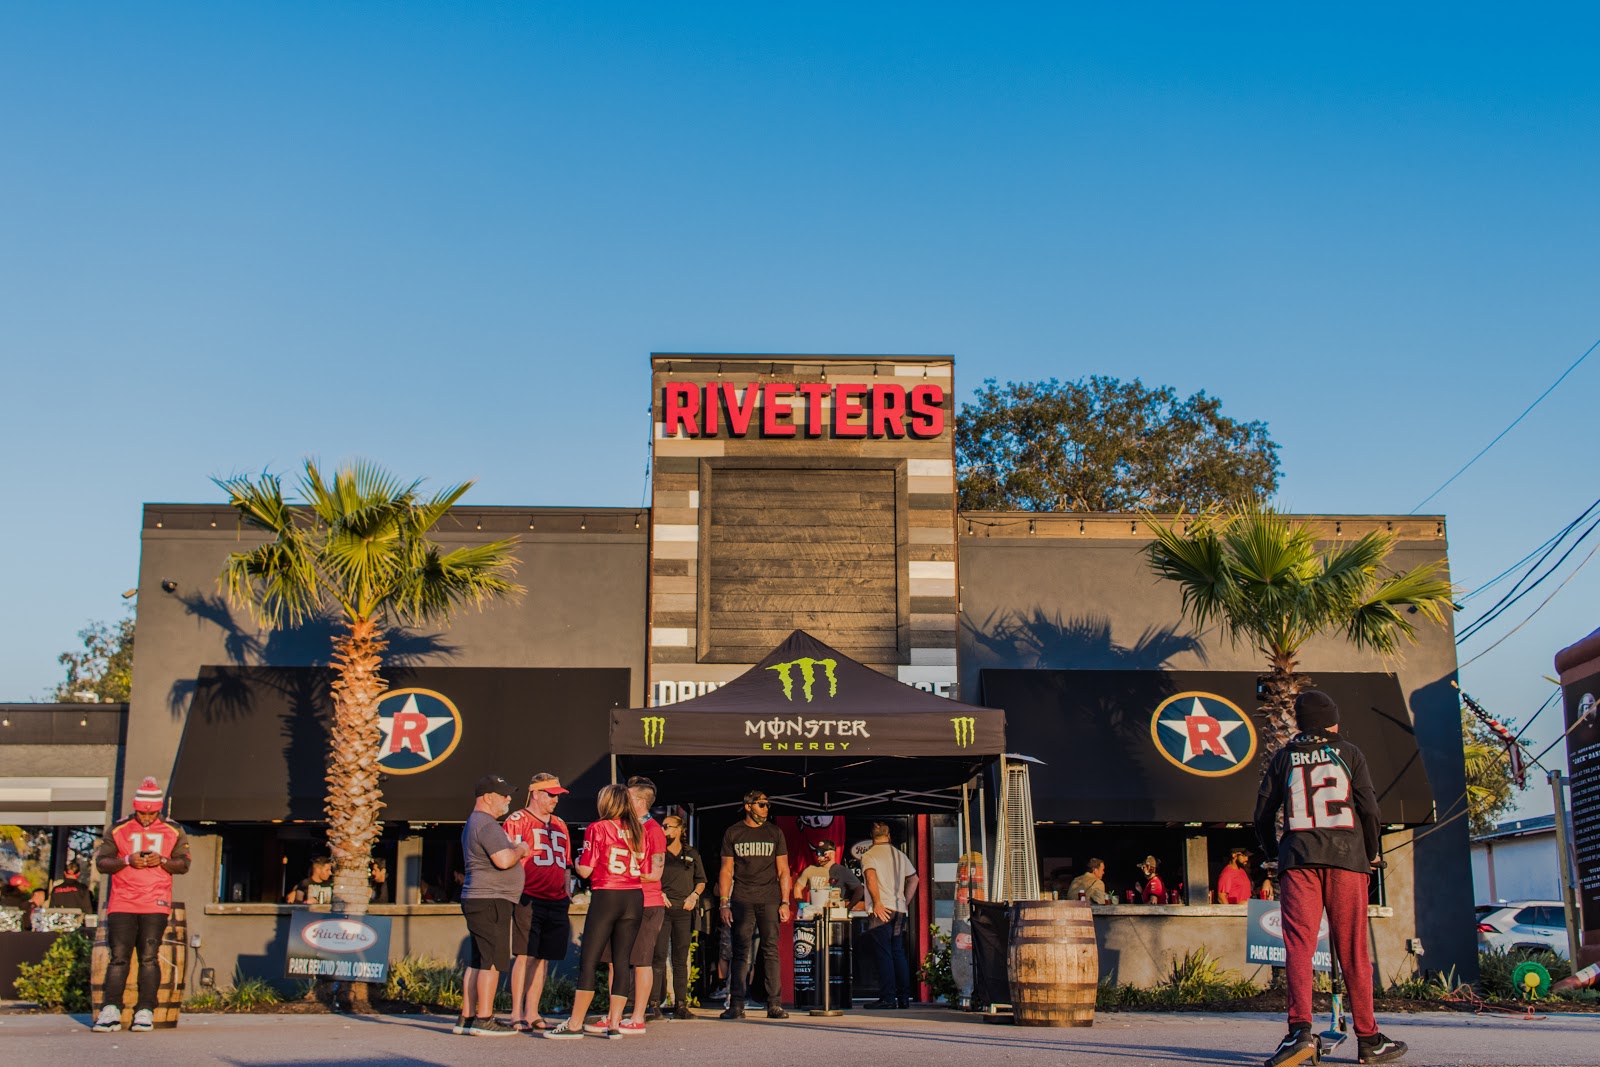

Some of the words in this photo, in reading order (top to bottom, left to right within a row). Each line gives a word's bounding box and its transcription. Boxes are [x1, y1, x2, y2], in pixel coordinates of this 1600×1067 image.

[665, 381, 944, 437] RIVETERS
[389, 711, 429, 753] R
[744, 716, 871, 740] MONSTER
[1184, 715, 1228, 756] R
[762, 742, 850, 751] ENERGY
[1287, 763, 1354, 831] 12
[129, 832, 164, 854] 13
[532, 828, 567, 869] 55
[734, 841, 774, 857] SECURITY
[1250, 945, 1268, 960] PARK
[289, 958, 309, 974] PARK
[308, 959, 335, 975] BEHIND
[335, 960, 352, 976] 2001
[352, 961, 384, 978] ODYSSEY
